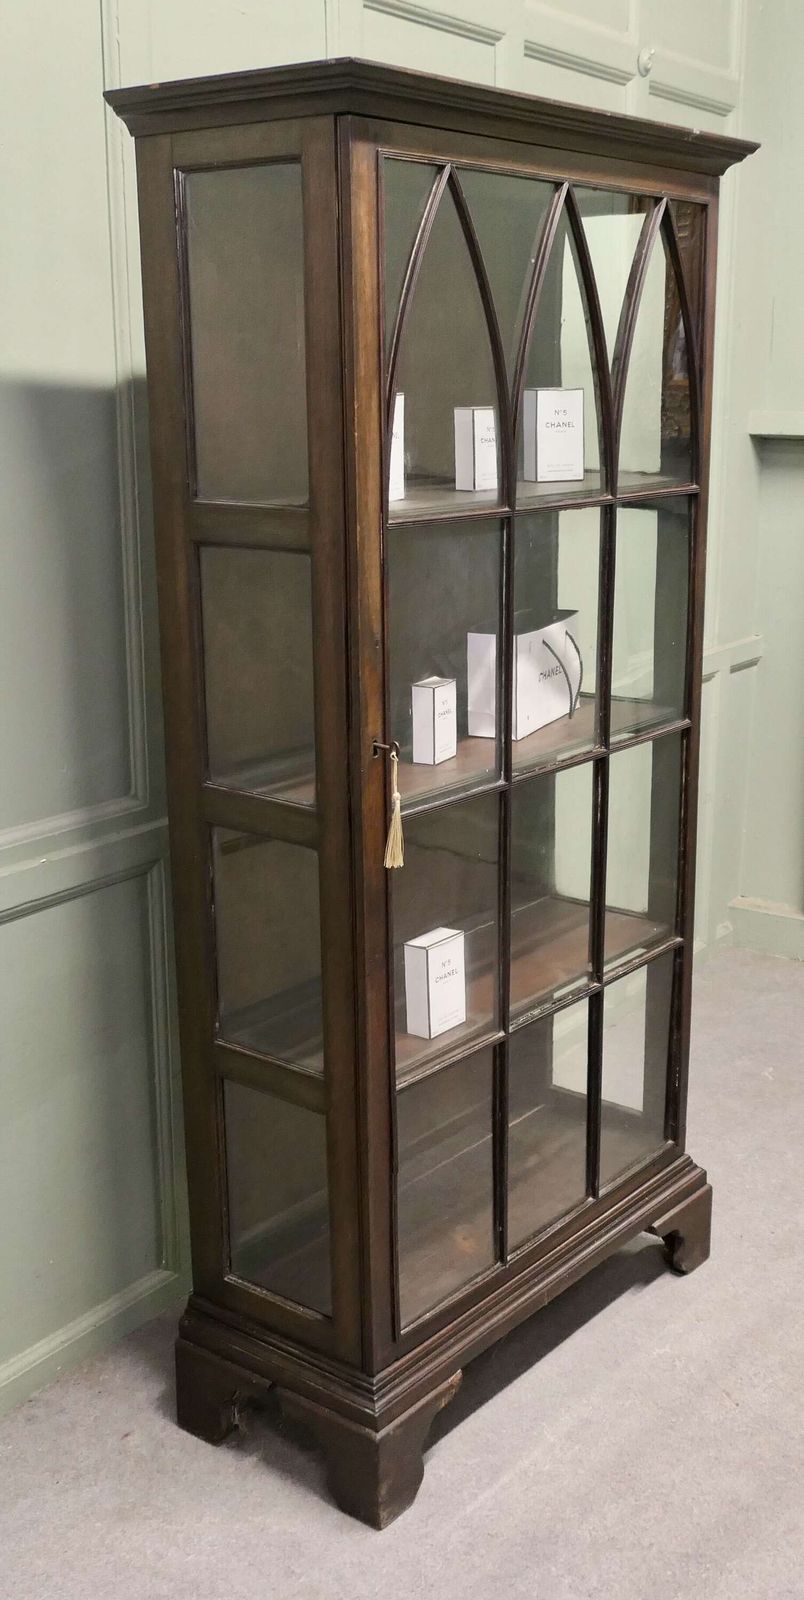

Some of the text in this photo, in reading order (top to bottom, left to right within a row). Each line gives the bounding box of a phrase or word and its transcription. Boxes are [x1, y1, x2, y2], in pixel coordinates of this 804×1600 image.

[545, 421, 575, 429] CHANEL
[539, 665, 562, 682] CHANEL
[435, 969, 458, 983] CHANEL
